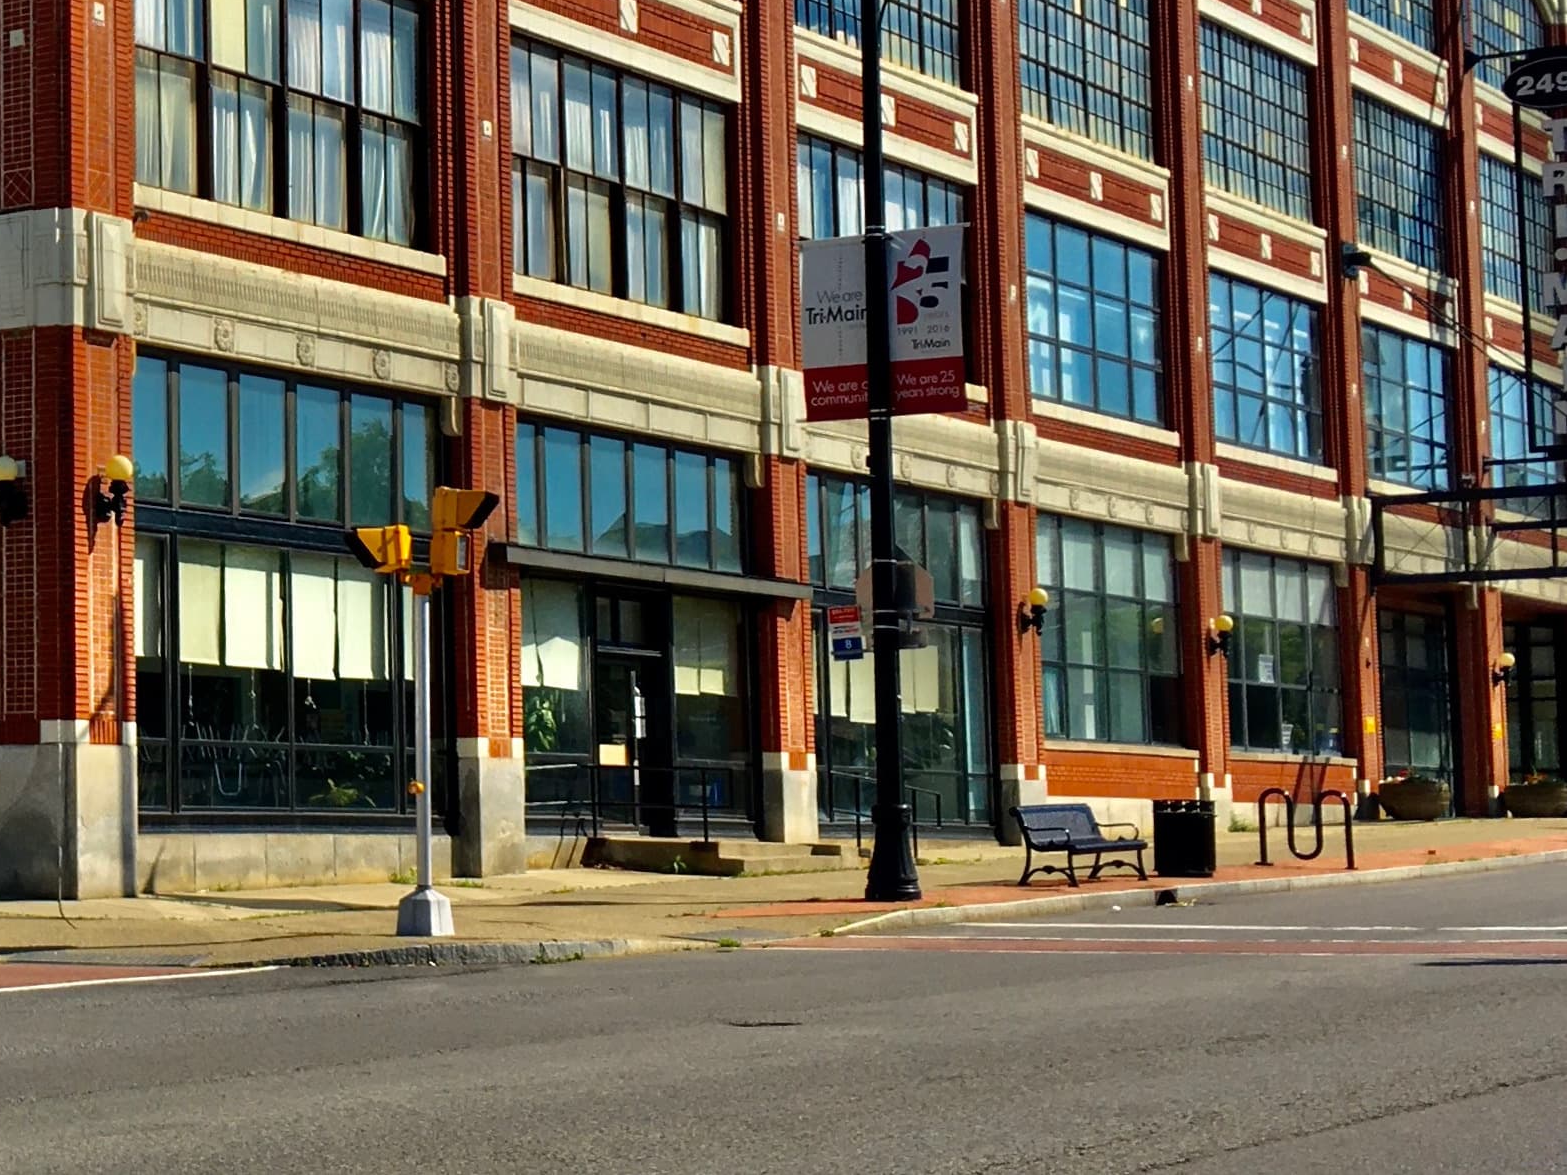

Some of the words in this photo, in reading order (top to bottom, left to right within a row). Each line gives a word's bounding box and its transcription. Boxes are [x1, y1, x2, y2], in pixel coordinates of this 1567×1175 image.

[817, 290, 840, 304] We
[842, 290, 863, 301] are
[896, 374, 917, 386] We
[919, 375, 939, 385] are
[940, 370, 956, 383] 25
[813, 380, 835, 394] We
[838, 381, 858, 392] are
[895, 388, 924, 402] years
[926, 385, 961, 398] strong
[810, 391, 868, 406] communit
